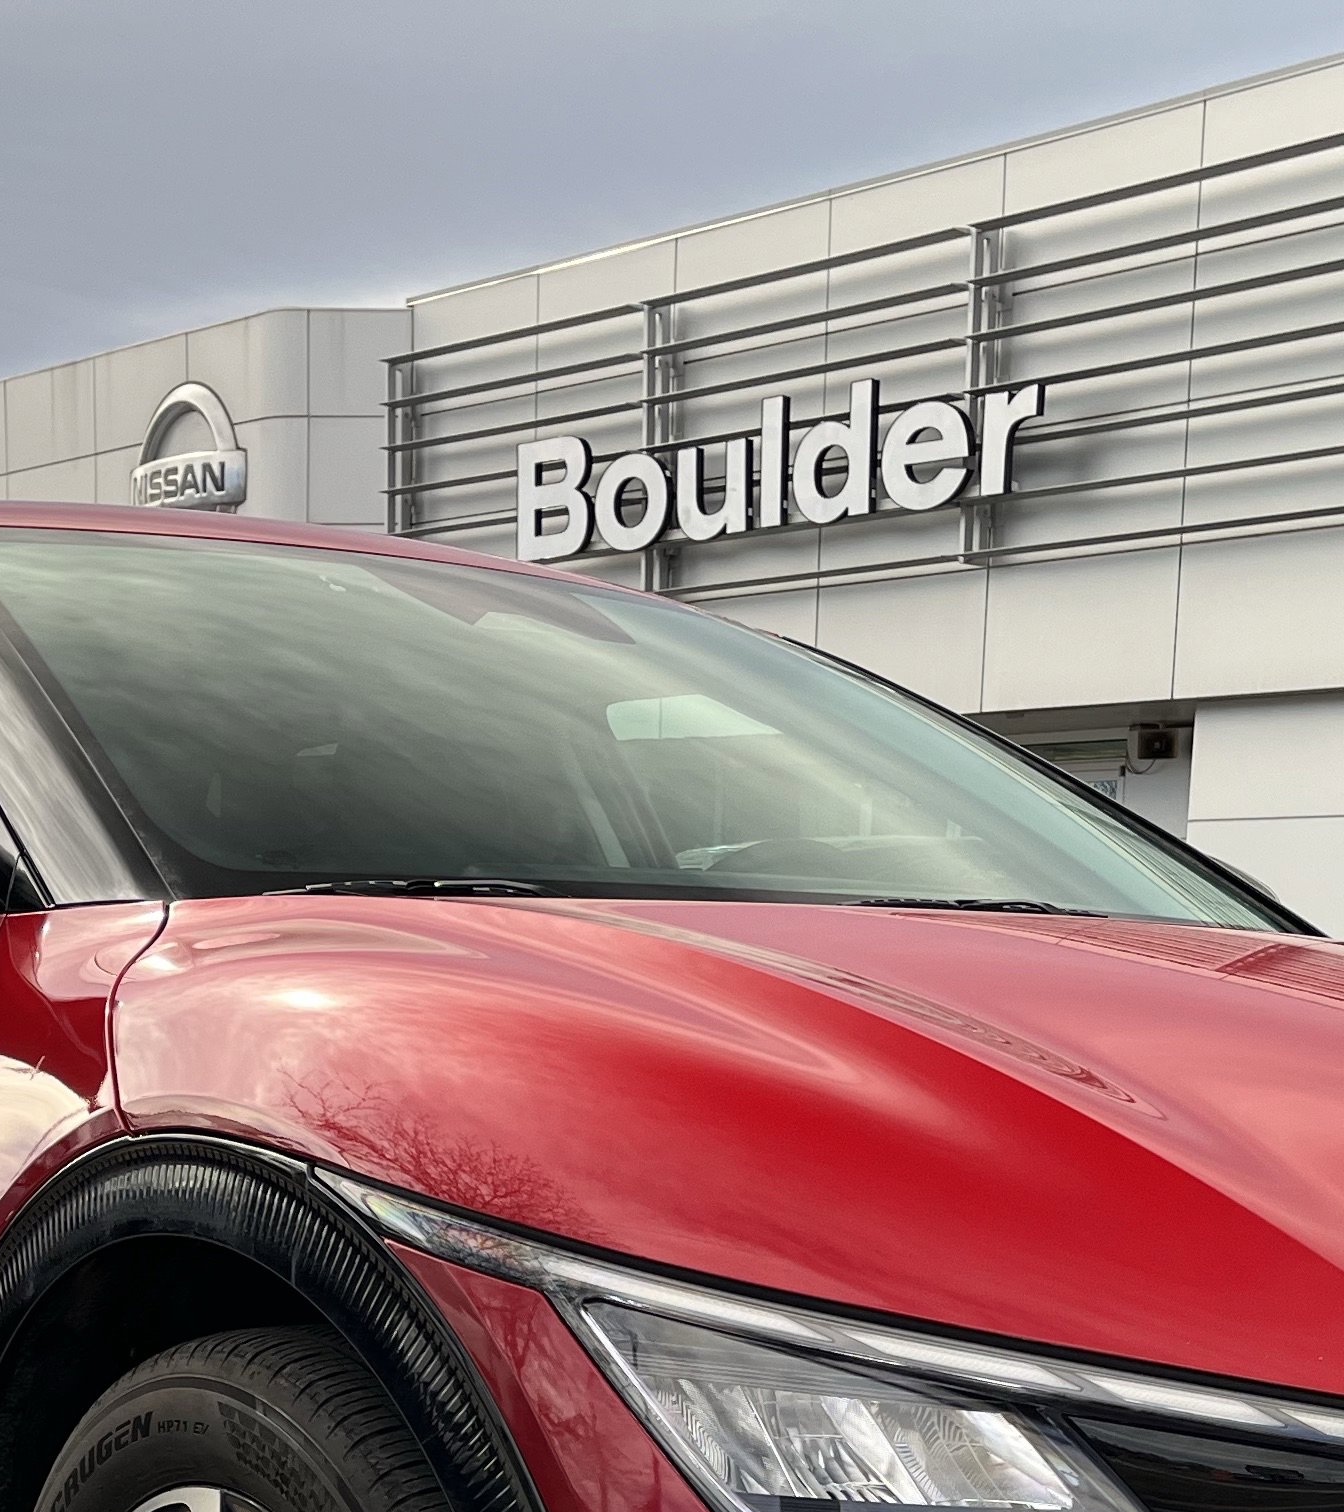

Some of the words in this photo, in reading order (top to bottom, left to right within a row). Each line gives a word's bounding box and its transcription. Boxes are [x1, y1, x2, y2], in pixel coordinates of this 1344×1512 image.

[133, 461, 226, 505] NISSAN
[517, 378, 1045, 561] Boulder
[157, 1419, 188, 1434] HP71
[193, 1421, 211, 1436] EV
